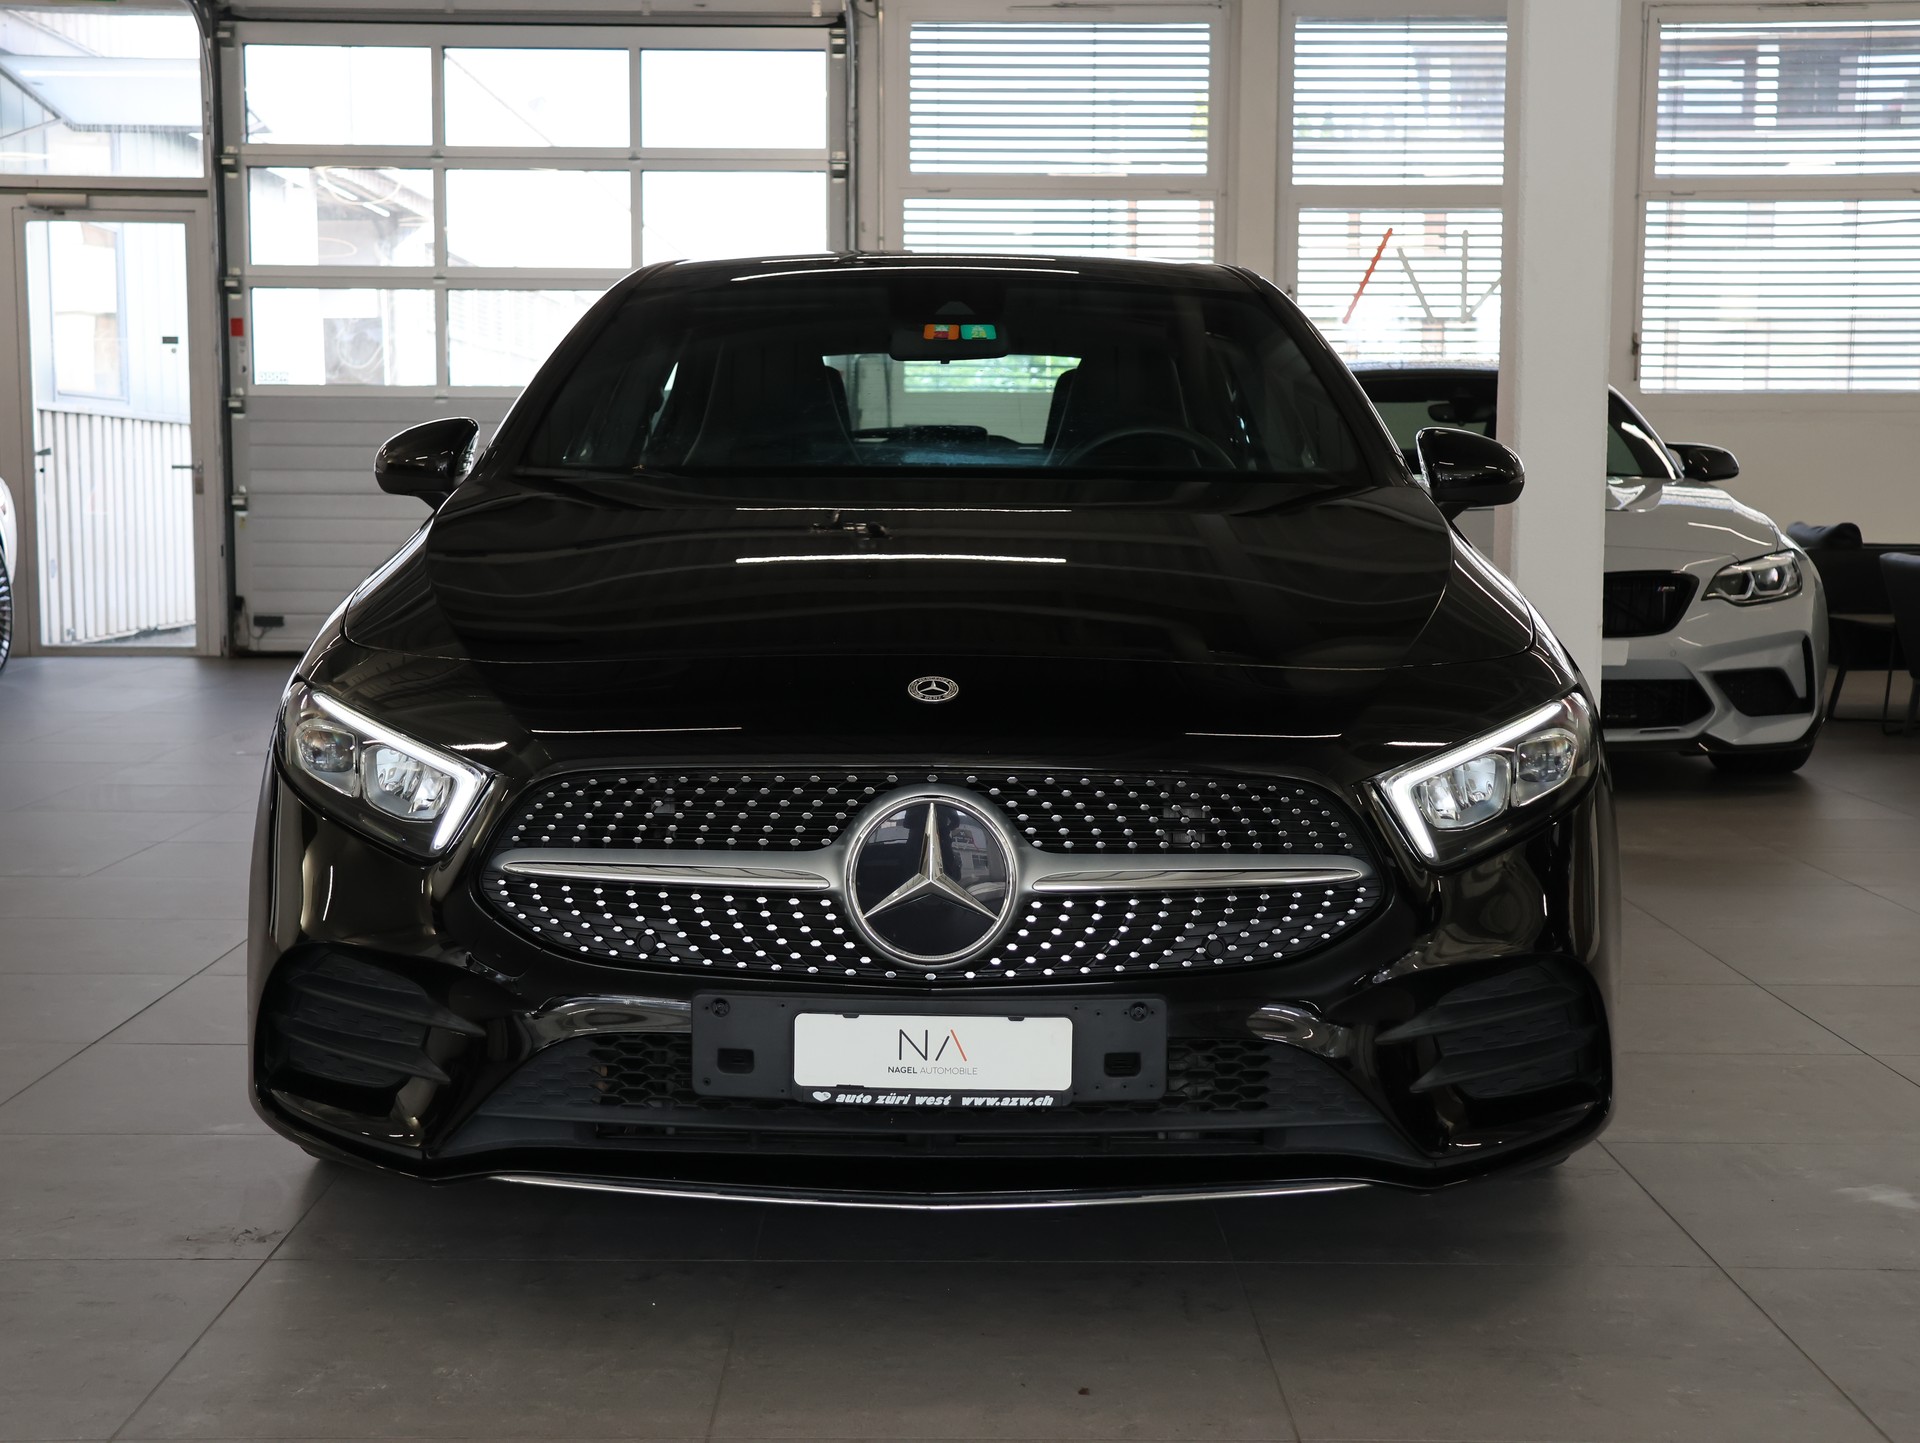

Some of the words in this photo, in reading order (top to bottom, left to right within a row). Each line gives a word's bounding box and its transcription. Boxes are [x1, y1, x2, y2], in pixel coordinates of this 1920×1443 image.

[887, 1066, 918, 1074] NAGEL
[920, 1067, 978, 1075] AUTOMOBILE
[835, 1093, 872, 1104] auto
[875, 1093, 911, 1105] züri
[915, 1094, 952, 1105] west
[961, 1095, 1054, 1106] www.azw.ch
